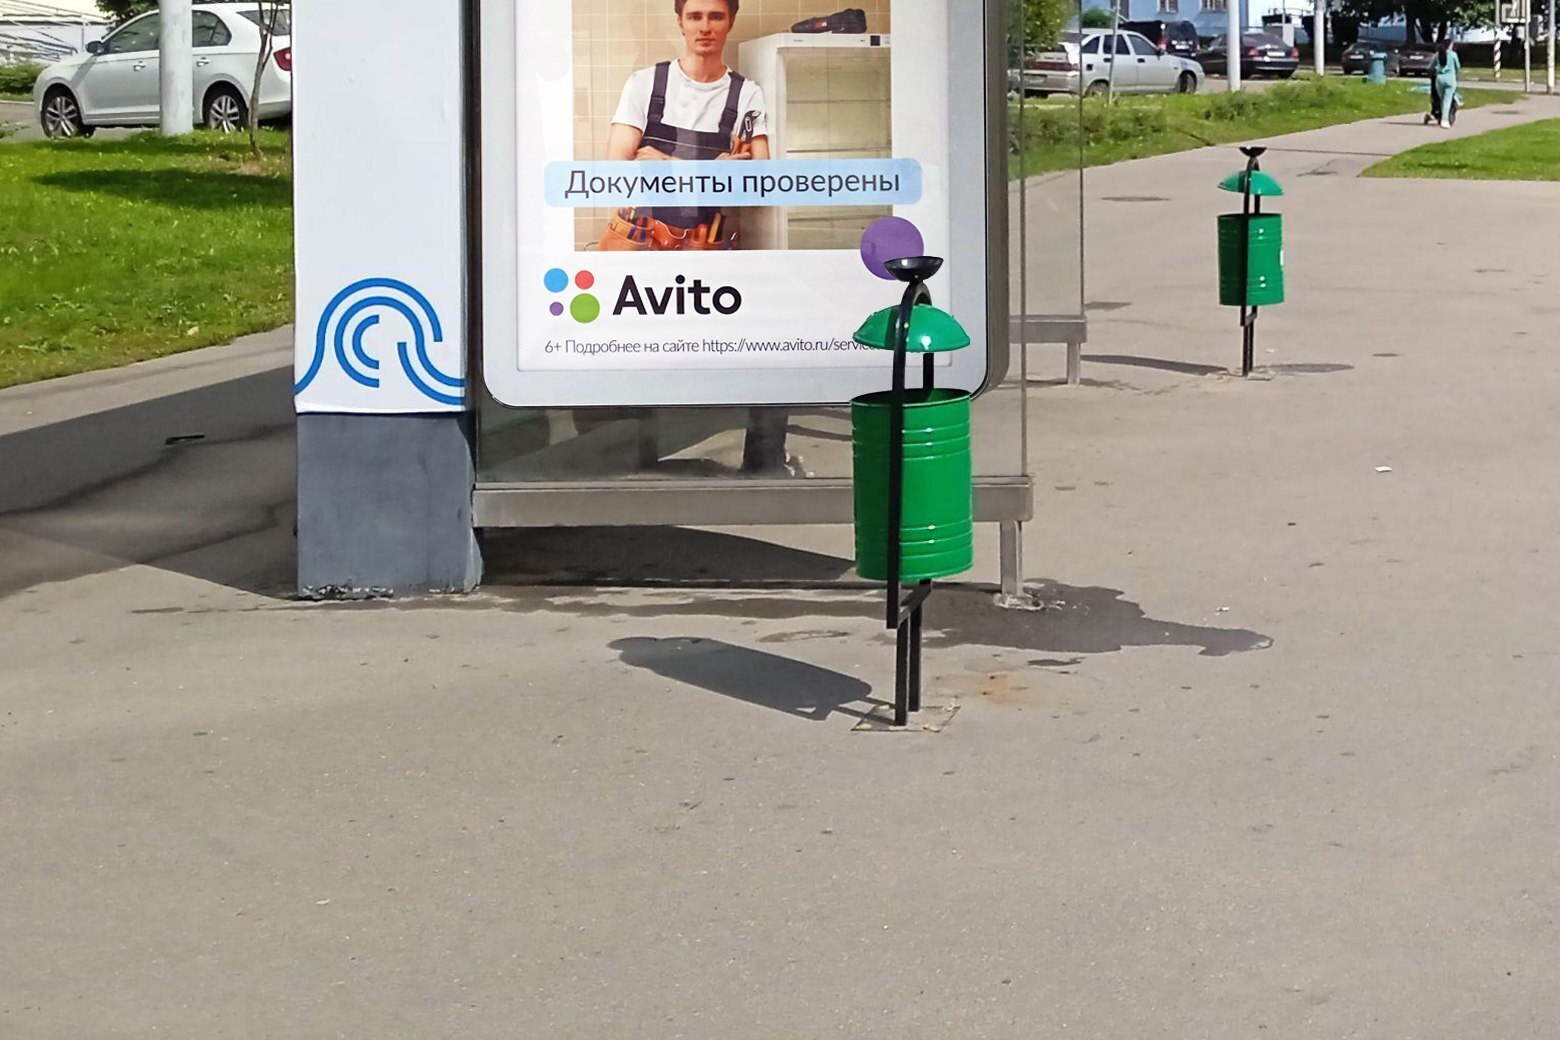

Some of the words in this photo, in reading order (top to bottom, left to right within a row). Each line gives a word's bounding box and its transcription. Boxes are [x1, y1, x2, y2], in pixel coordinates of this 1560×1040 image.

[564, 170, 732, 199] Документы
[742, 173, 900, 197] проверены
[612, 275, 742, 315] Avito
[544, 340, 562, 353] 6+
[565, 339, 641, 355] Подробнее
[644, 342, 660, 353] на
[662, 339, 700, 352] сайте
